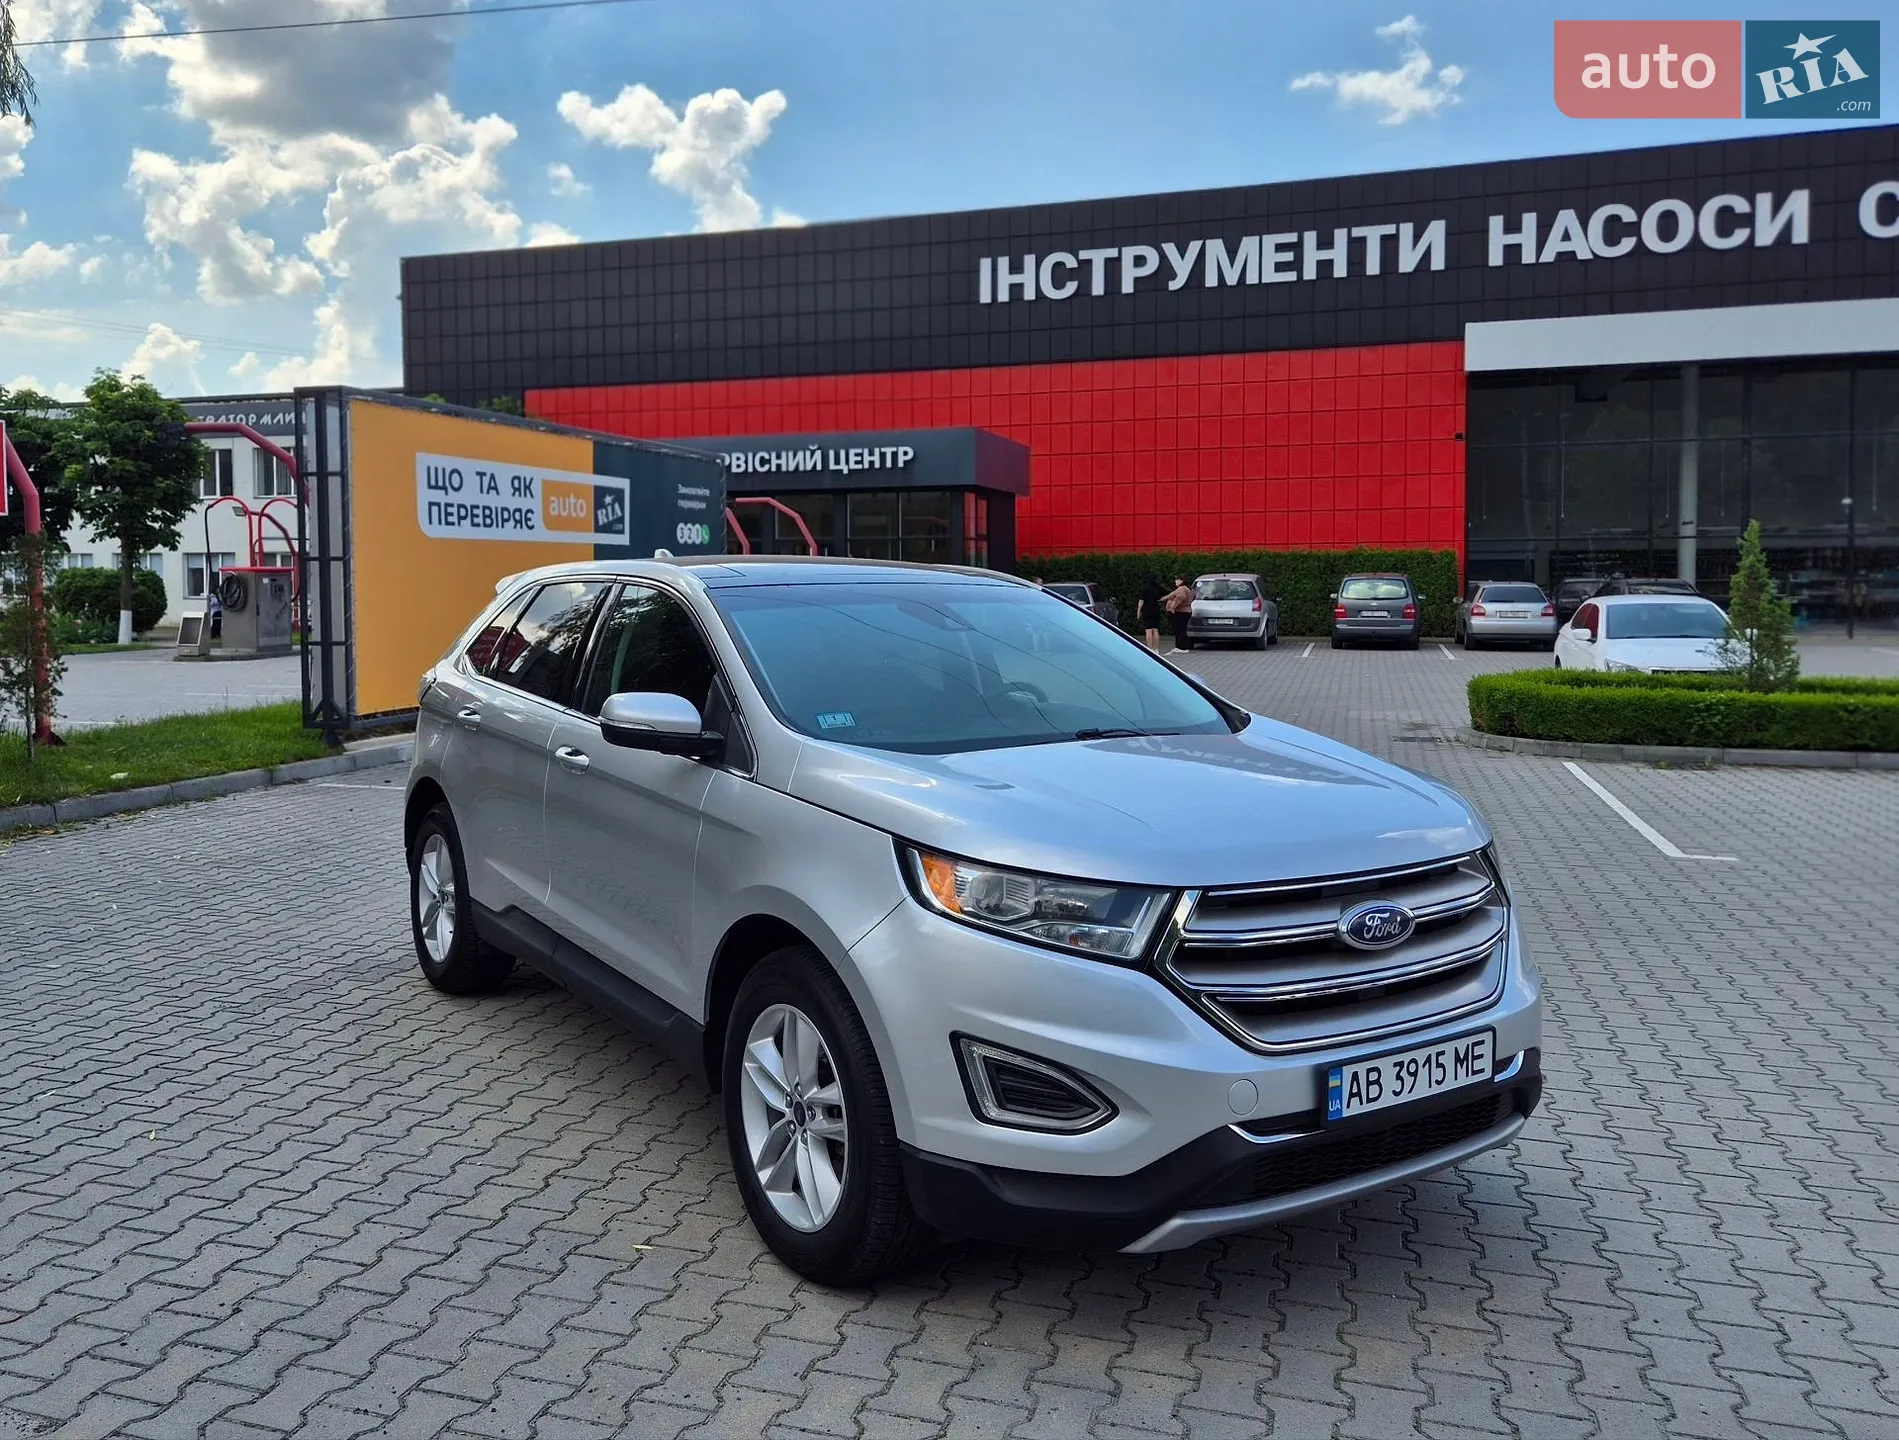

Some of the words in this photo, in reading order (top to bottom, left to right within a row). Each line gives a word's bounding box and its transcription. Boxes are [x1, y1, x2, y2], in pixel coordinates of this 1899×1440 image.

[979, 219, 1446, 304] ІНСТРУМЕНТИ
[1488, 189, 1810, 267] НАСОСИ
[828, 446, 915, 475] ЦЕНТР
[426, 465, 464, 496] ЩО
[475, 470, 501, 496] ТА
[510, 475, 535, 500] ЯК
[427, 501, 536, 531] ПЕРЕВІРЯЄ
[548, 491, 588, 519] auto
[596, 501, 623, 527] RIA
[1363, 912, 1402, 940] Ford
[1346, 1065, 1384, 1110] AB
[1391, 1049, 1447, 1098] 3915
[1454, 1038, 1486, 1082] ME
[1328, 1099, 1342, 1112] UA
